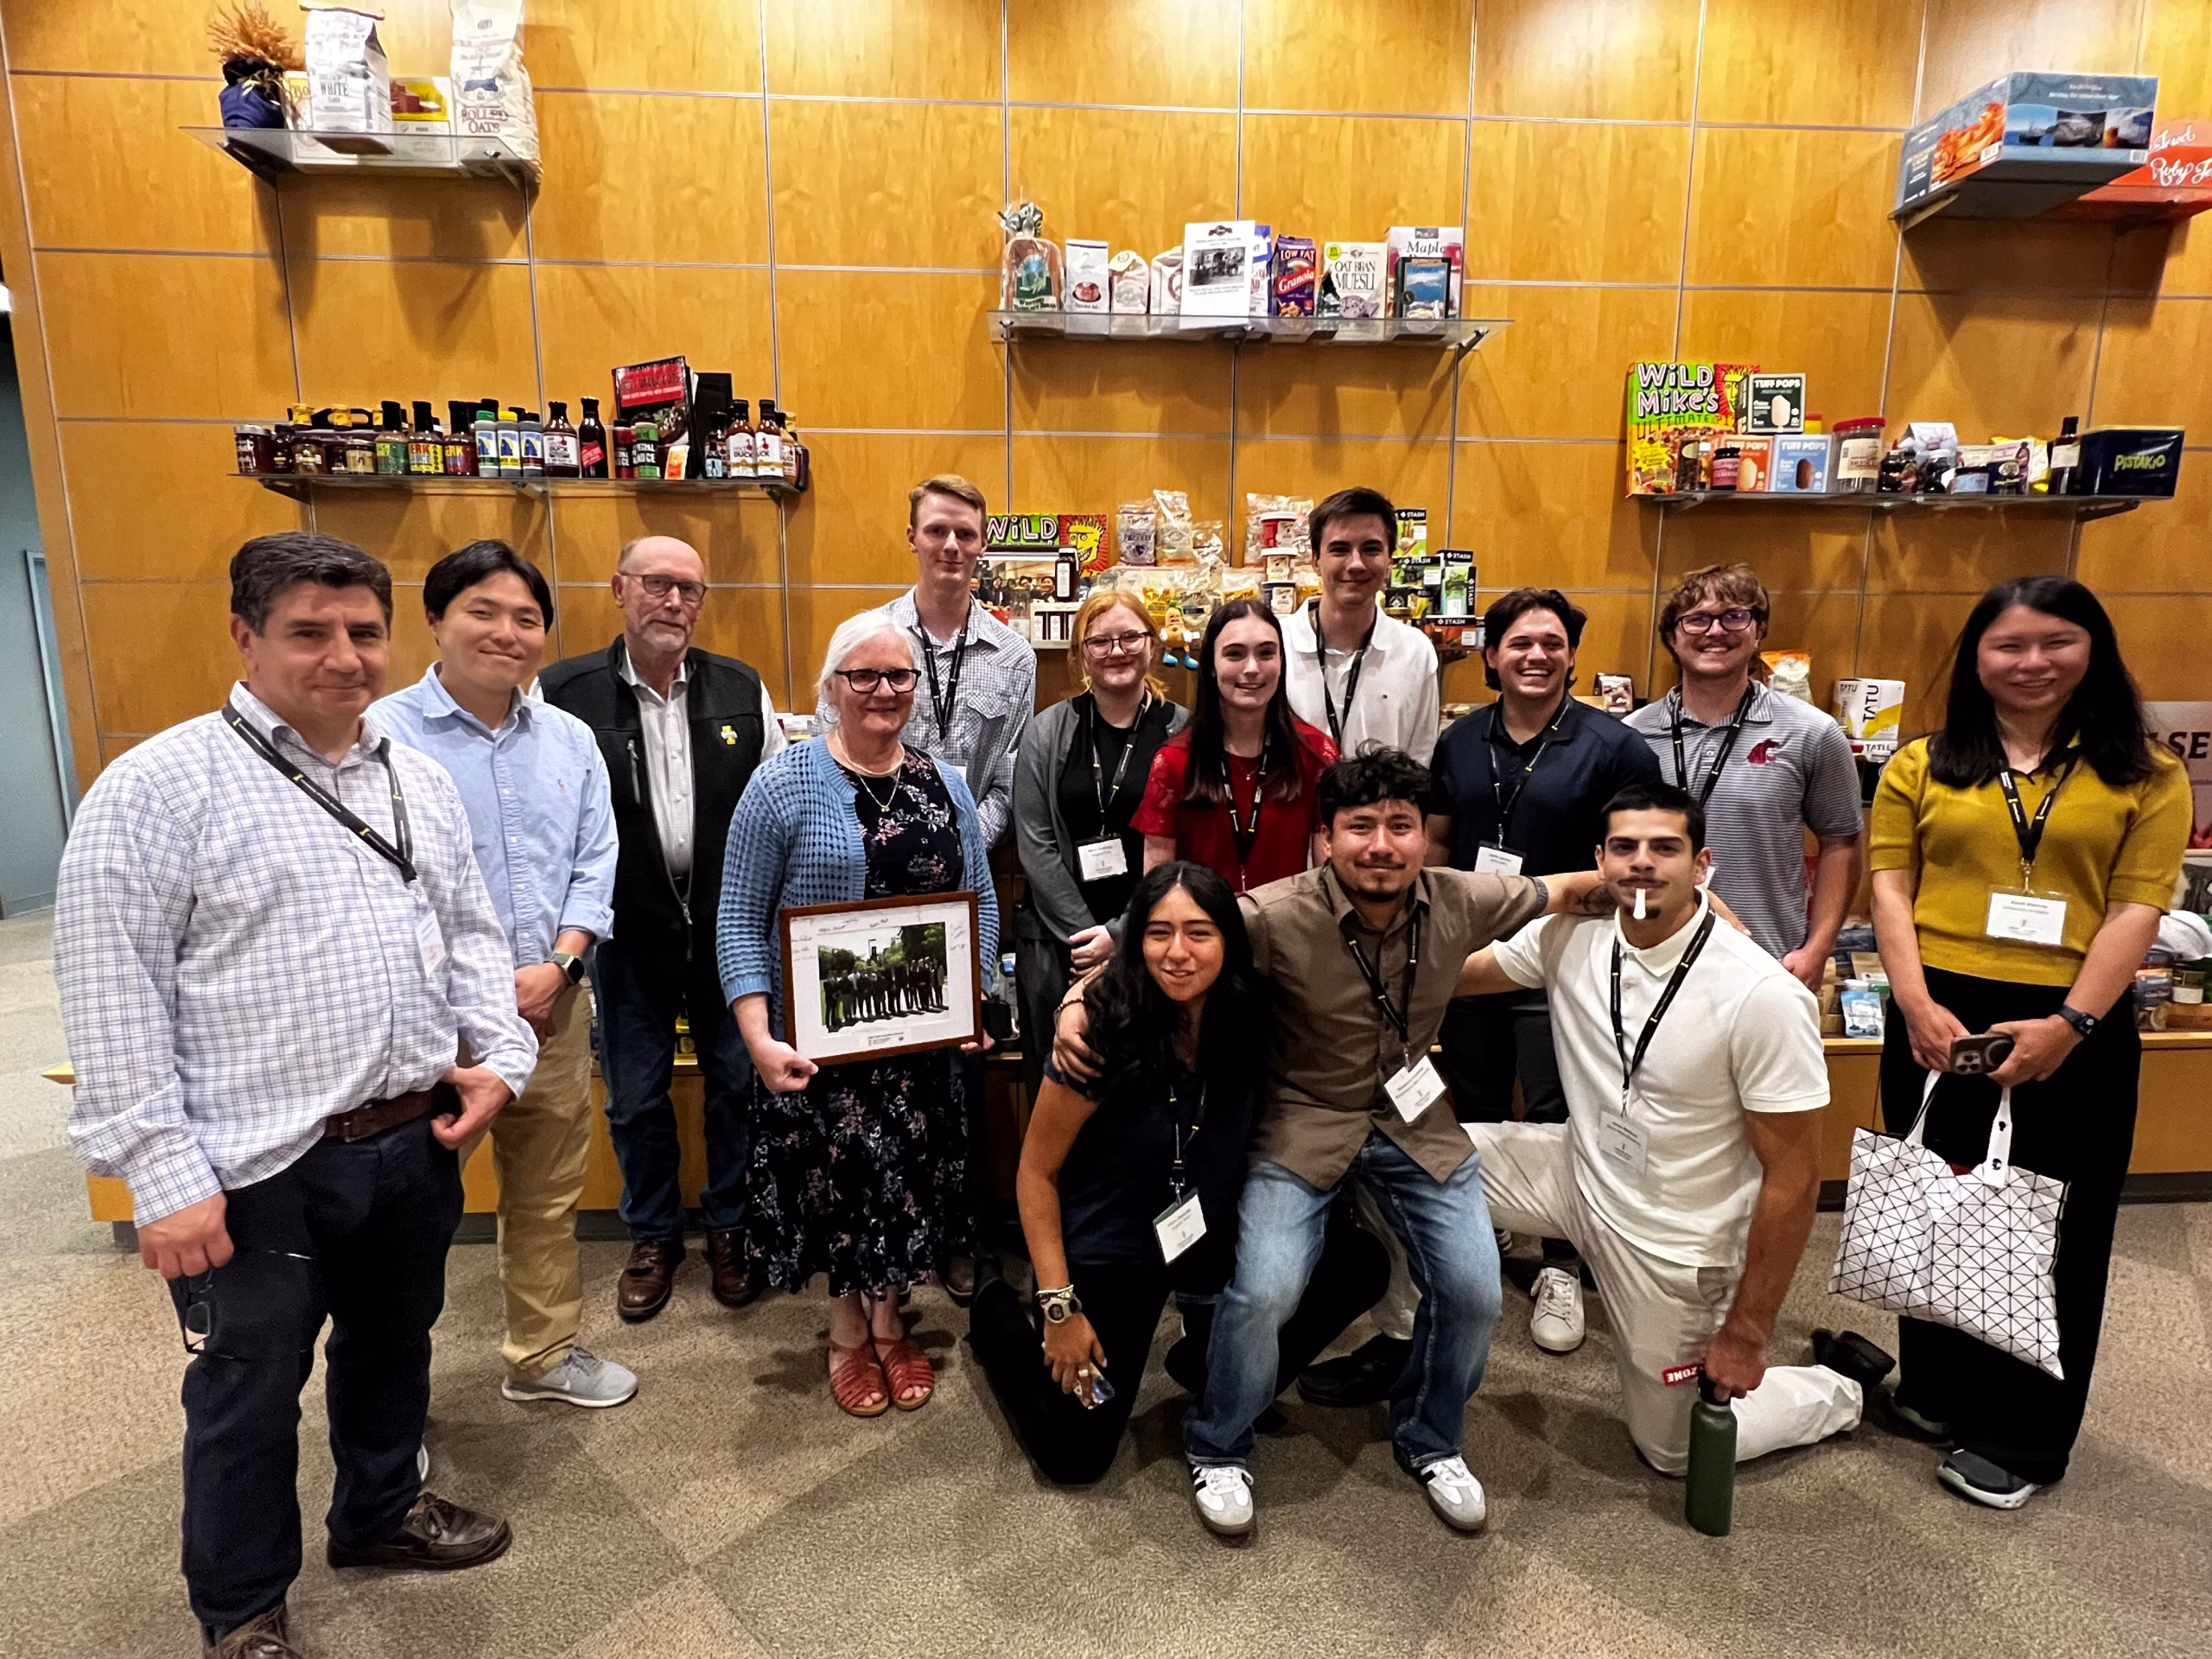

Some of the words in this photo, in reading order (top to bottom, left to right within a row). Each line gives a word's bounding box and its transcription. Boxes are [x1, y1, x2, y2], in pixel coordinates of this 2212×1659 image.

[319, 82, 348, 95] WHITE
[461, 109, 508, 122] ROLLED
[468, 120, 500, 133] OATS
[2150, 157, 2194, 187] Ruby
[1406, 241, 1447, 256] Maple
[1281, 249, 1298, 261] LOW
[1300, 250, 1316, 262] FAT
[1334, 261, 1351, 272] OAT
[1354, 261, 1376, 272] BRAN
[1279, 269, 1314, 292] Granola
[1336, 273, 1375, 290] MUESLI
[1754, 379, 1776, 389] TUFF
[1776, 378, 1801, 388] POPS
[1637, 387, 1719, 418] Mike's
[1637, 415, 1710, 441] ULTIMATE
[1745, 442, 1768, 450] POPS
[1781, 442, 1802, 450] TUFF
[1802, 442, 1827, 450] POPS
[1840, 683, 1858, 693] TATU
[1862, 684, 1879, 723] TATU
